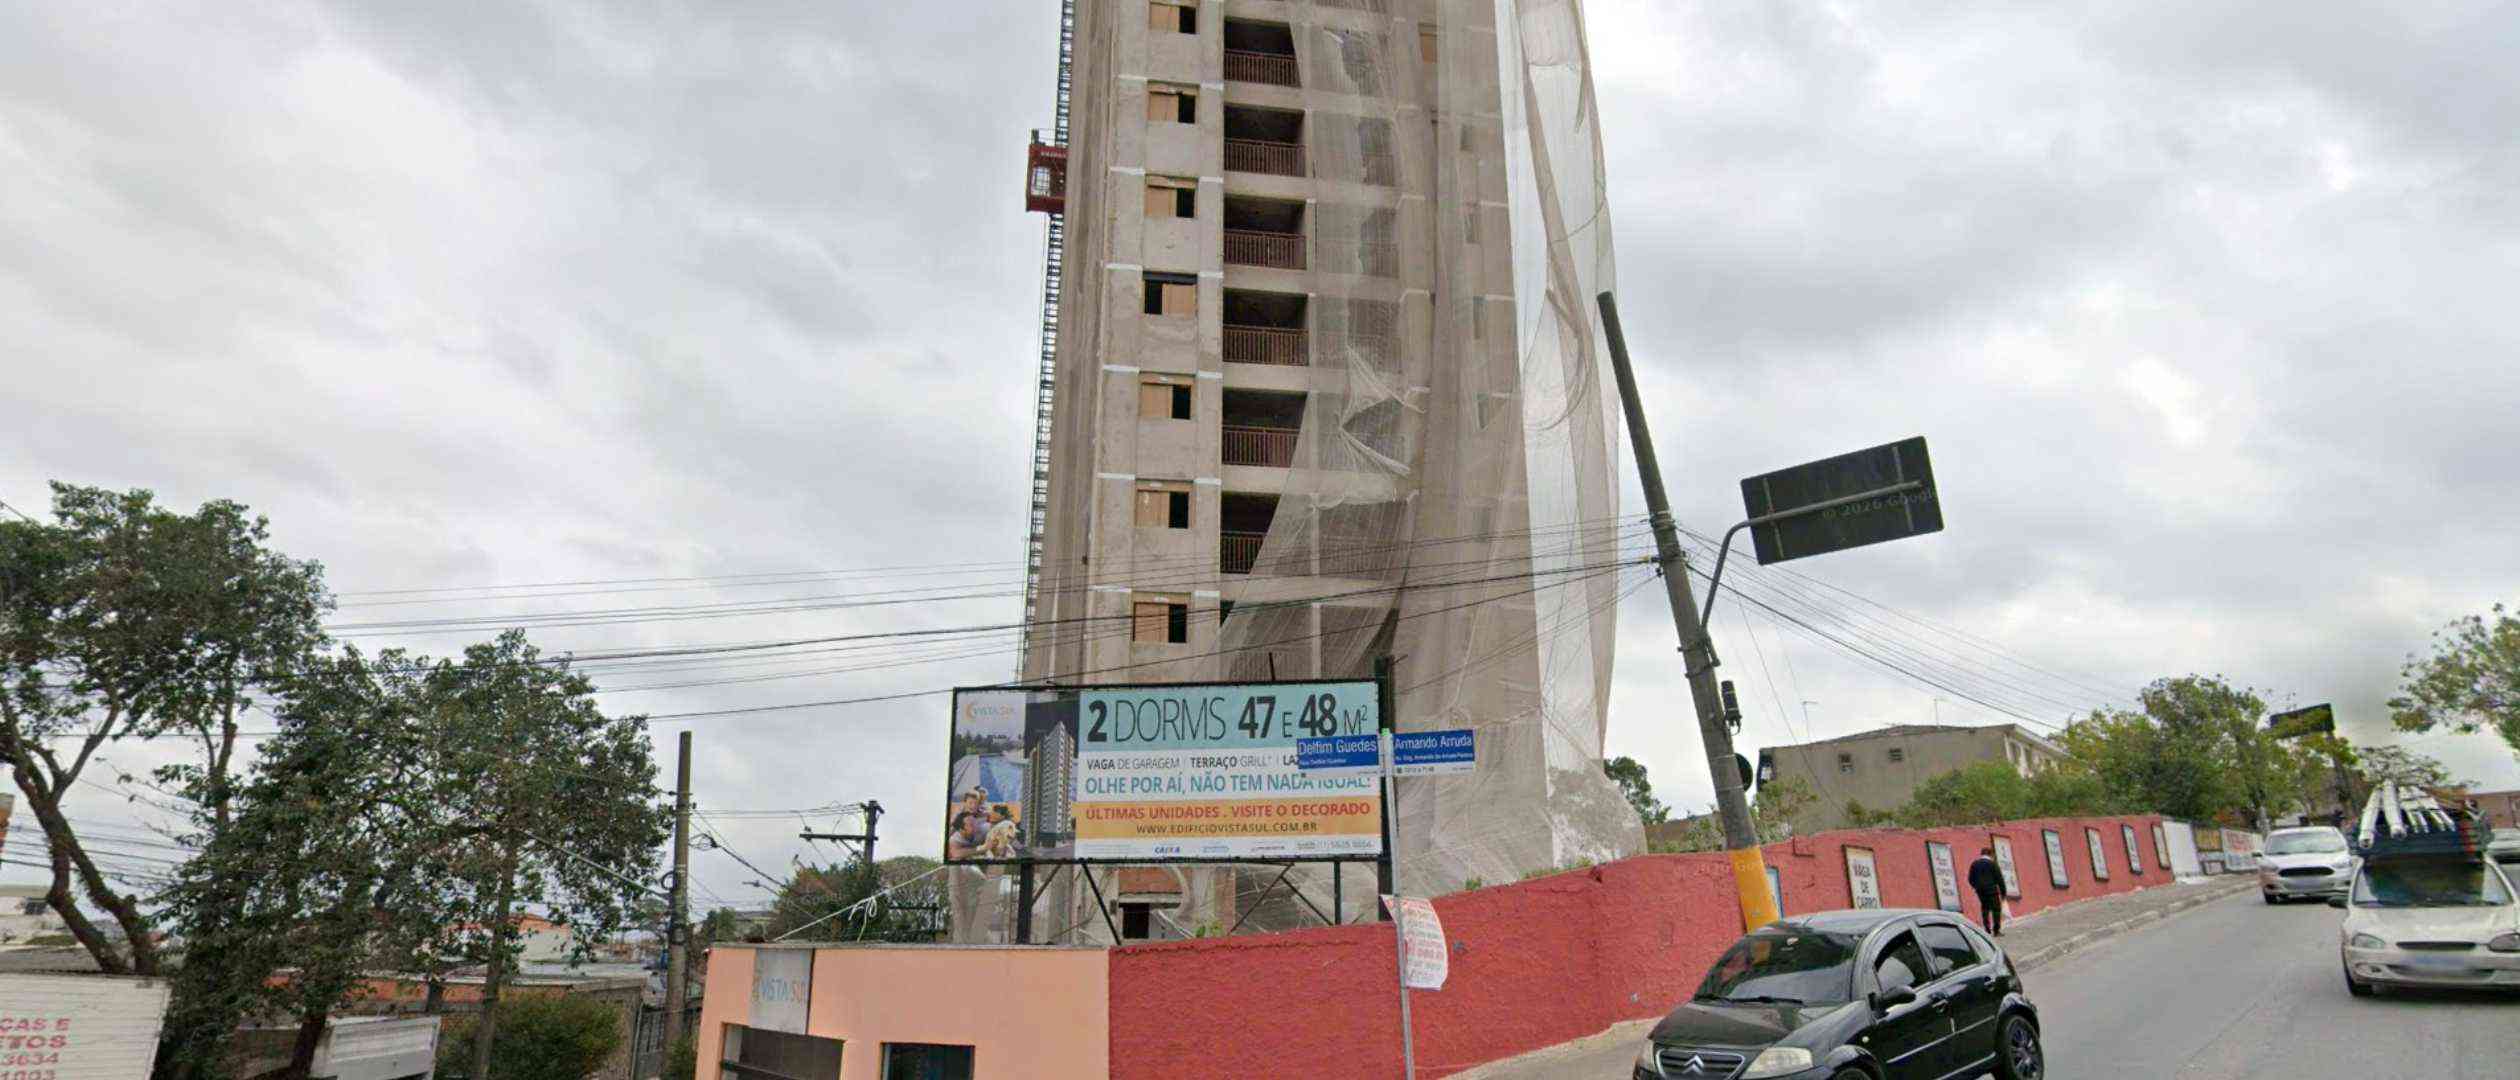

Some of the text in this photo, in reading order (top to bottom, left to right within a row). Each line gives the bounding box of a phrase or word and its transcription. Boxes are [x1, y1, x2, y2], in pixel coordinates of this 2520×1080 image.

[1088, 700, 1107, 742] 2
[1115, 697, 1226, 742] DORMS
[1238, 696, 1276, 739] 47
[1282, 712, 1292, 738] E
[1298, 693, 1337, 737] 48
[1298, 738, 1377, 755] Delfim Guedes
[1395, 734, 1472, 750] Armando Arruda
[1087, 758, 1115, 770] VAGA
[1117, 759, 1130, 769] DE
[1132, 758, 1179, 770] GARAGEM
[1190, 756, 1237, 770] TERRAÇO
[1086, 776, 1126, 794] OLHE
[1131, 776, 1162, 793] POR
[1190, 771, 1226, 792] NÃO
[1231, 774, 1262, 791] TEM
[1267, 773, 1314, 790] NADA
[1150, 805, 1219, 819] UNIDADES
[1231, 804, 1272, 817] VISITE
[1276, 803, 1287, 816] O
[1291, 802, 1371, 816] DECORADO
[56, 1018, 71, 1031] E
